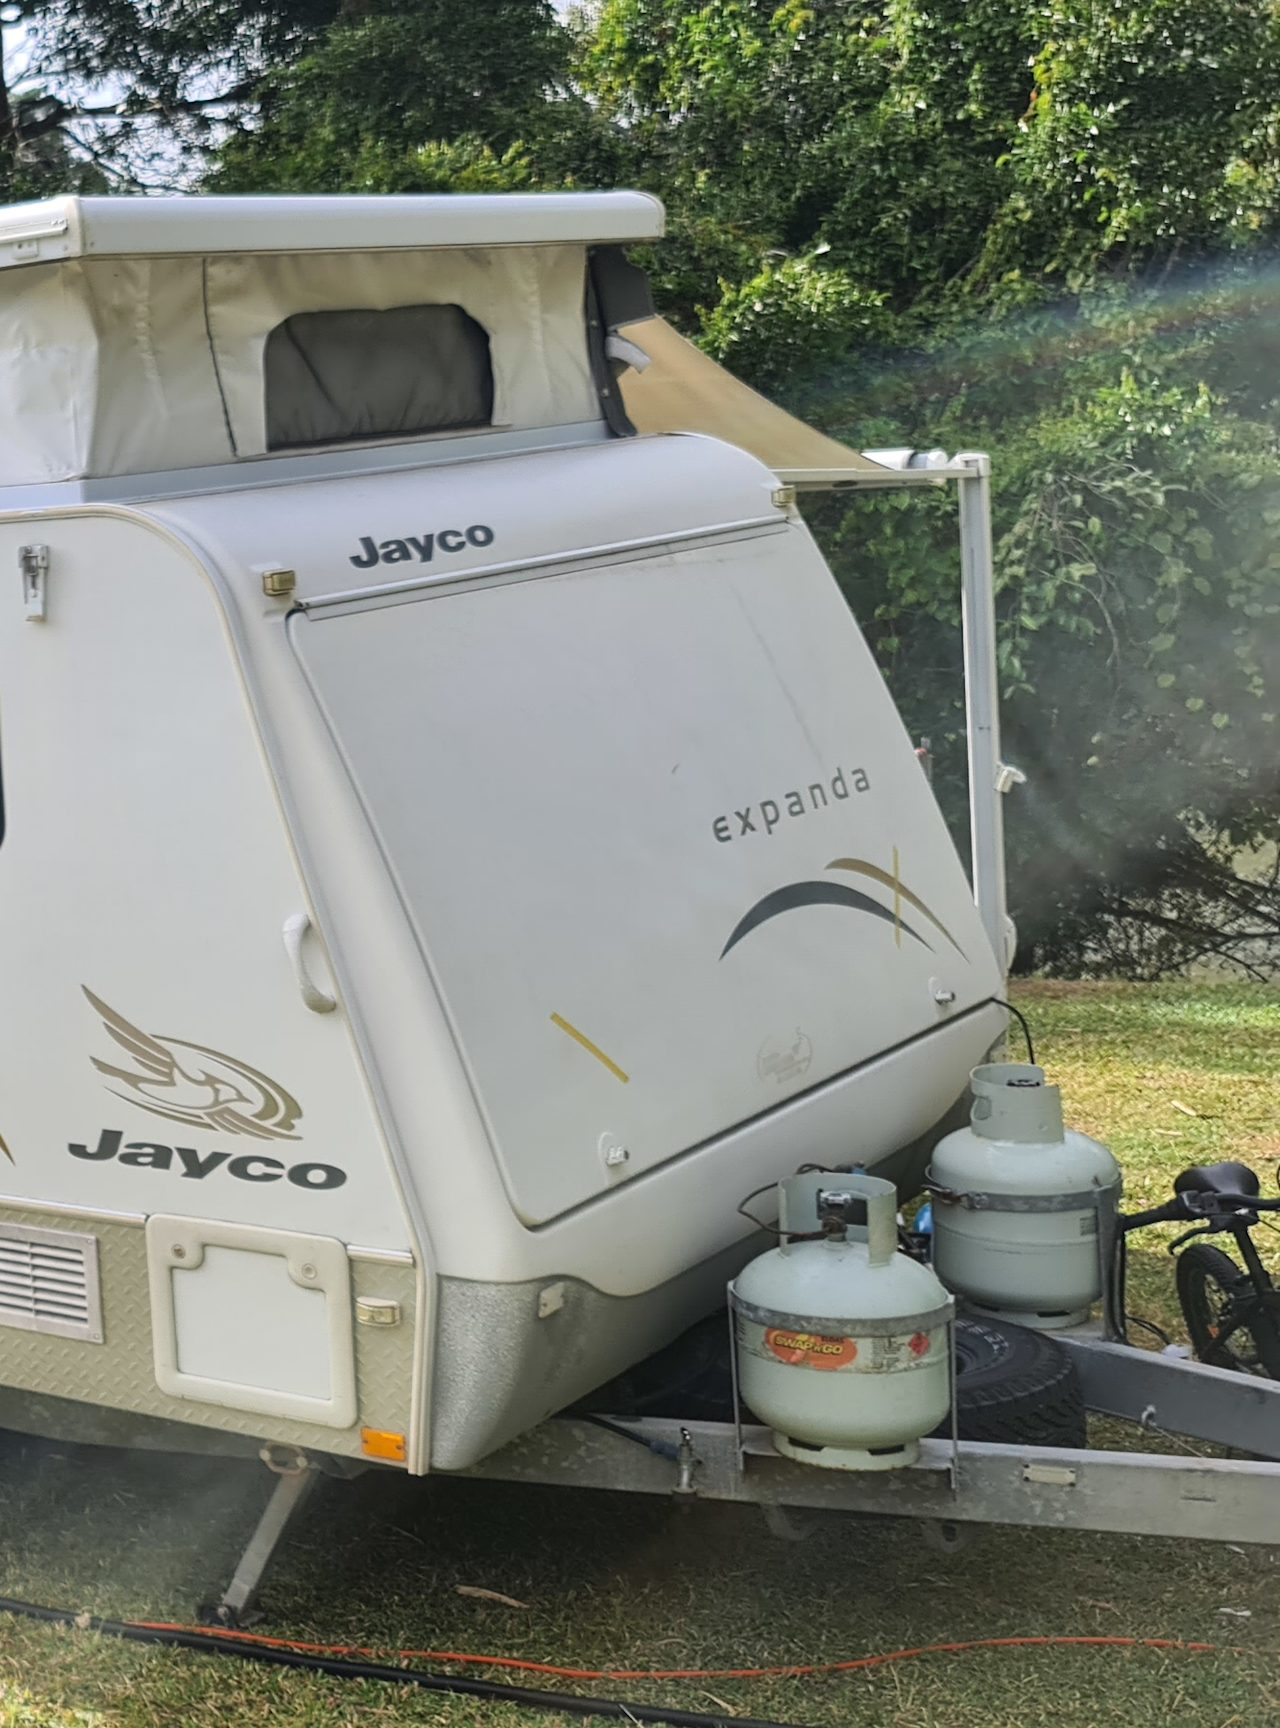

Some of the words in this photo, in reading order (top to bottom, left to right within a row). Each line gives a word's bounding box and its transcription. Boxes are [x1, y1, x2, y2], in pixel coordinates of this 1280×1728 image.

[348, 524, 495, 569] Jayco
[711, 766, 871, 843] expanda
[67, 1128, 348, 1191] Jayco
